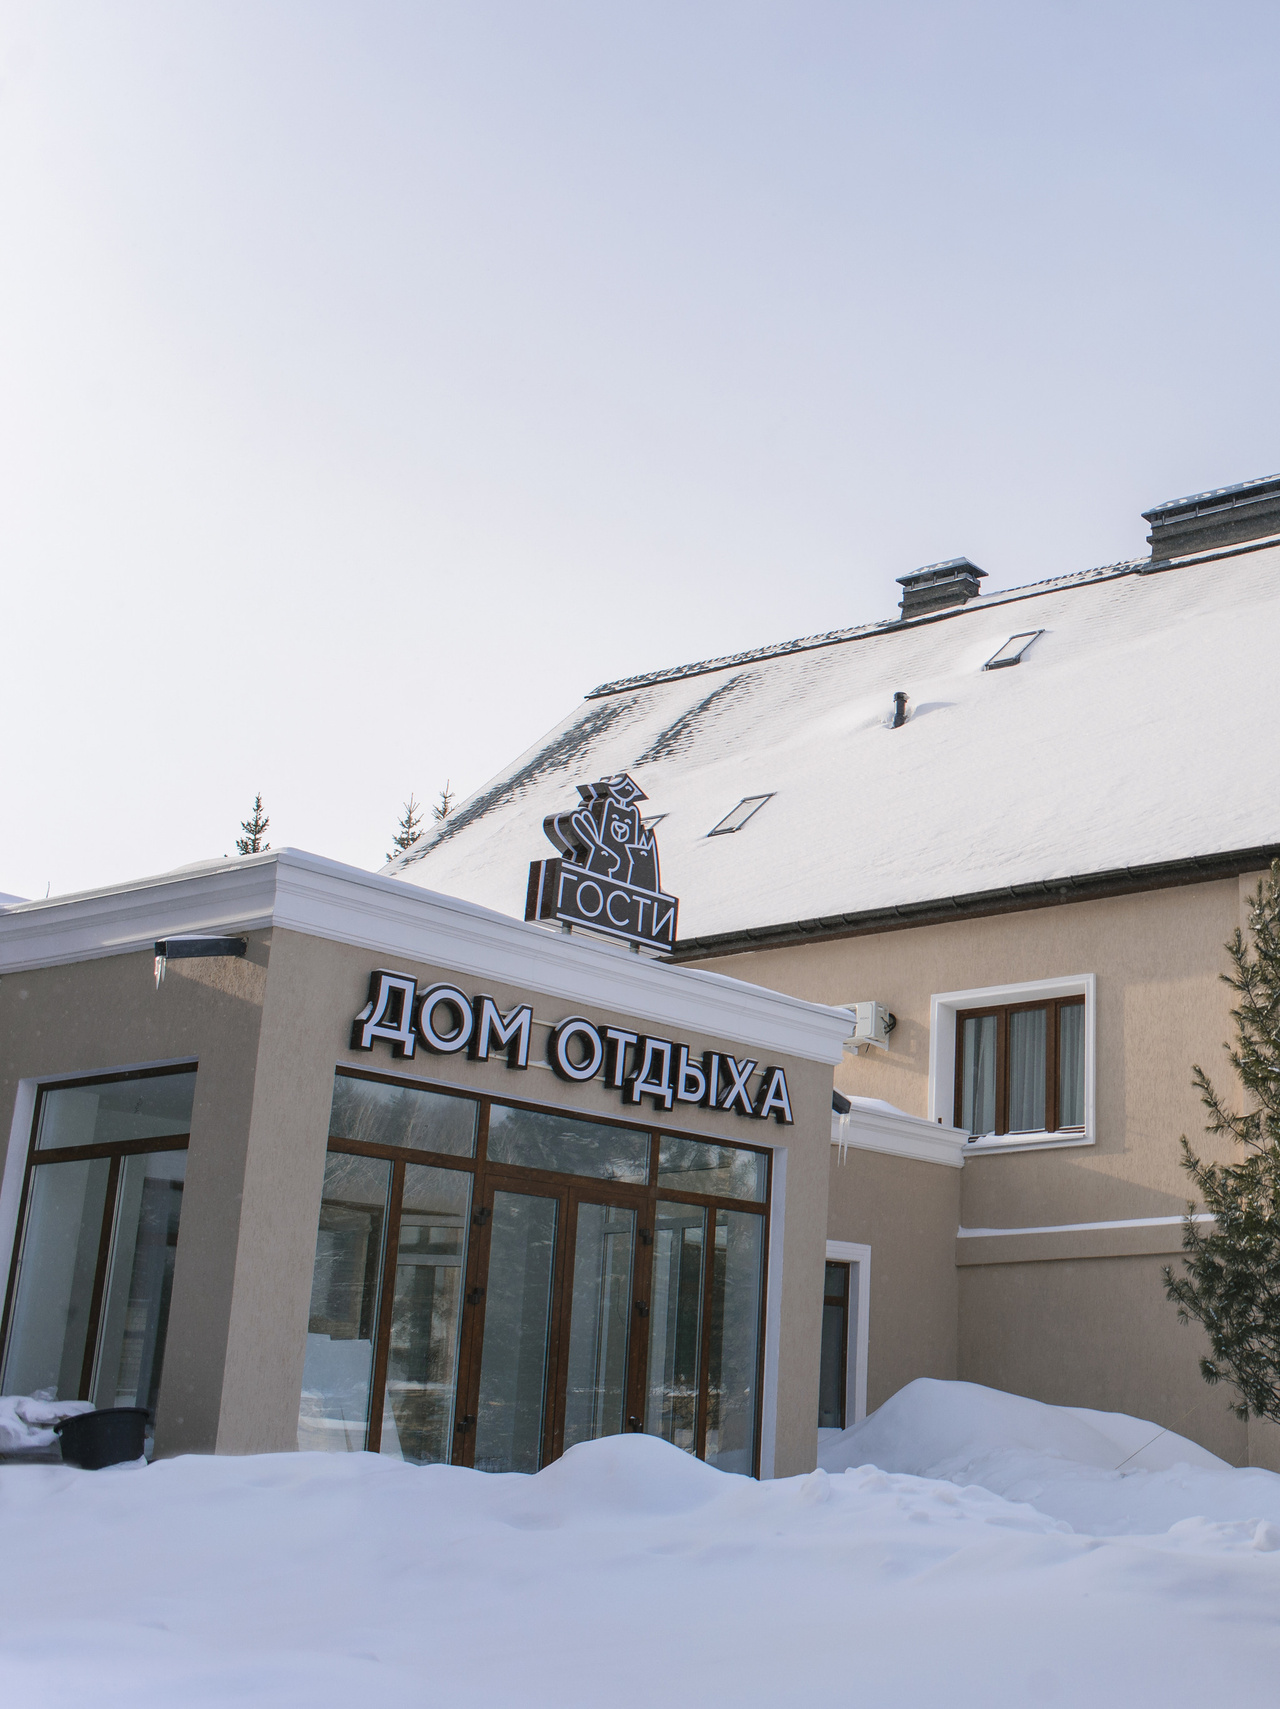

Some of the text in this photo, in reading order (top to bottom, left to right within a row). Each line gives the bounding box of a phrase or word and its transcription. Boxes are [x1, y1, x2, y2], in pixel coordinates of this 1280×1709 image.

[556, 871, 675, 942] ГОСТИ
[358, 973, 794, 1123] ДОМ ОТДЫХА
